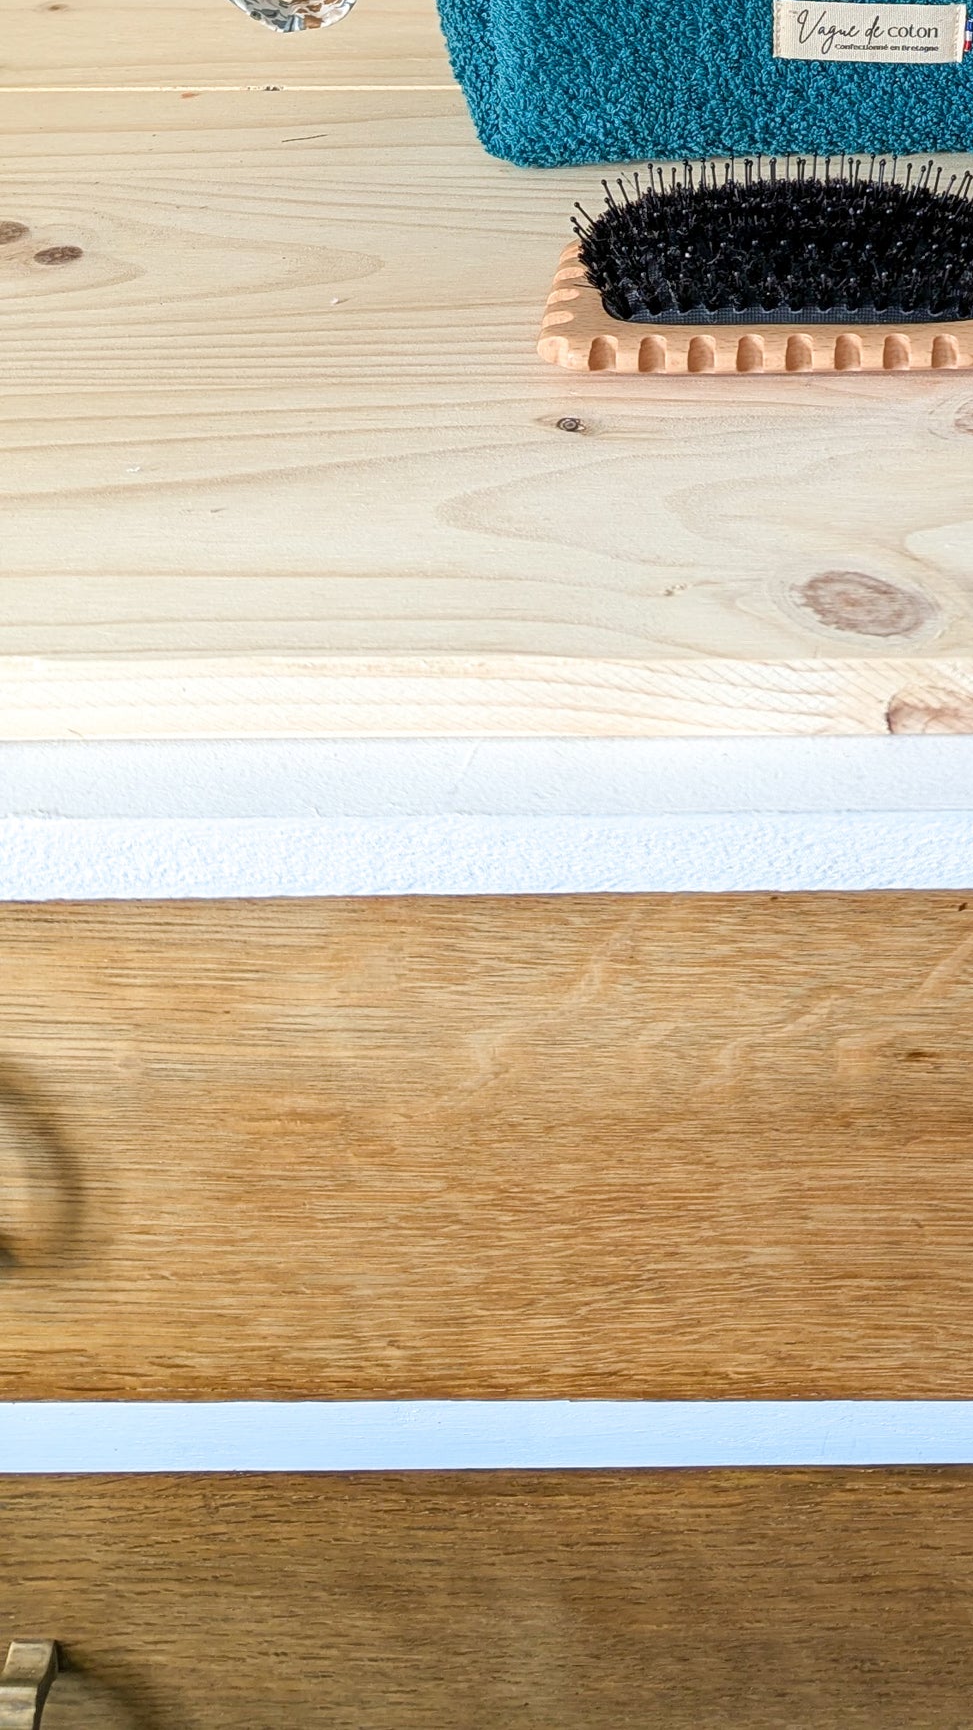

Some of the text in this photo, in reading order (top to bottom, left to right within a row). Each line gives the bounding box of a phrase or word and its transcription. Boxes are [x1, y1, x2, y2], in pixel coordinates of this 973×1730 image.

[797, 9, 938, 54] Vague de coton
